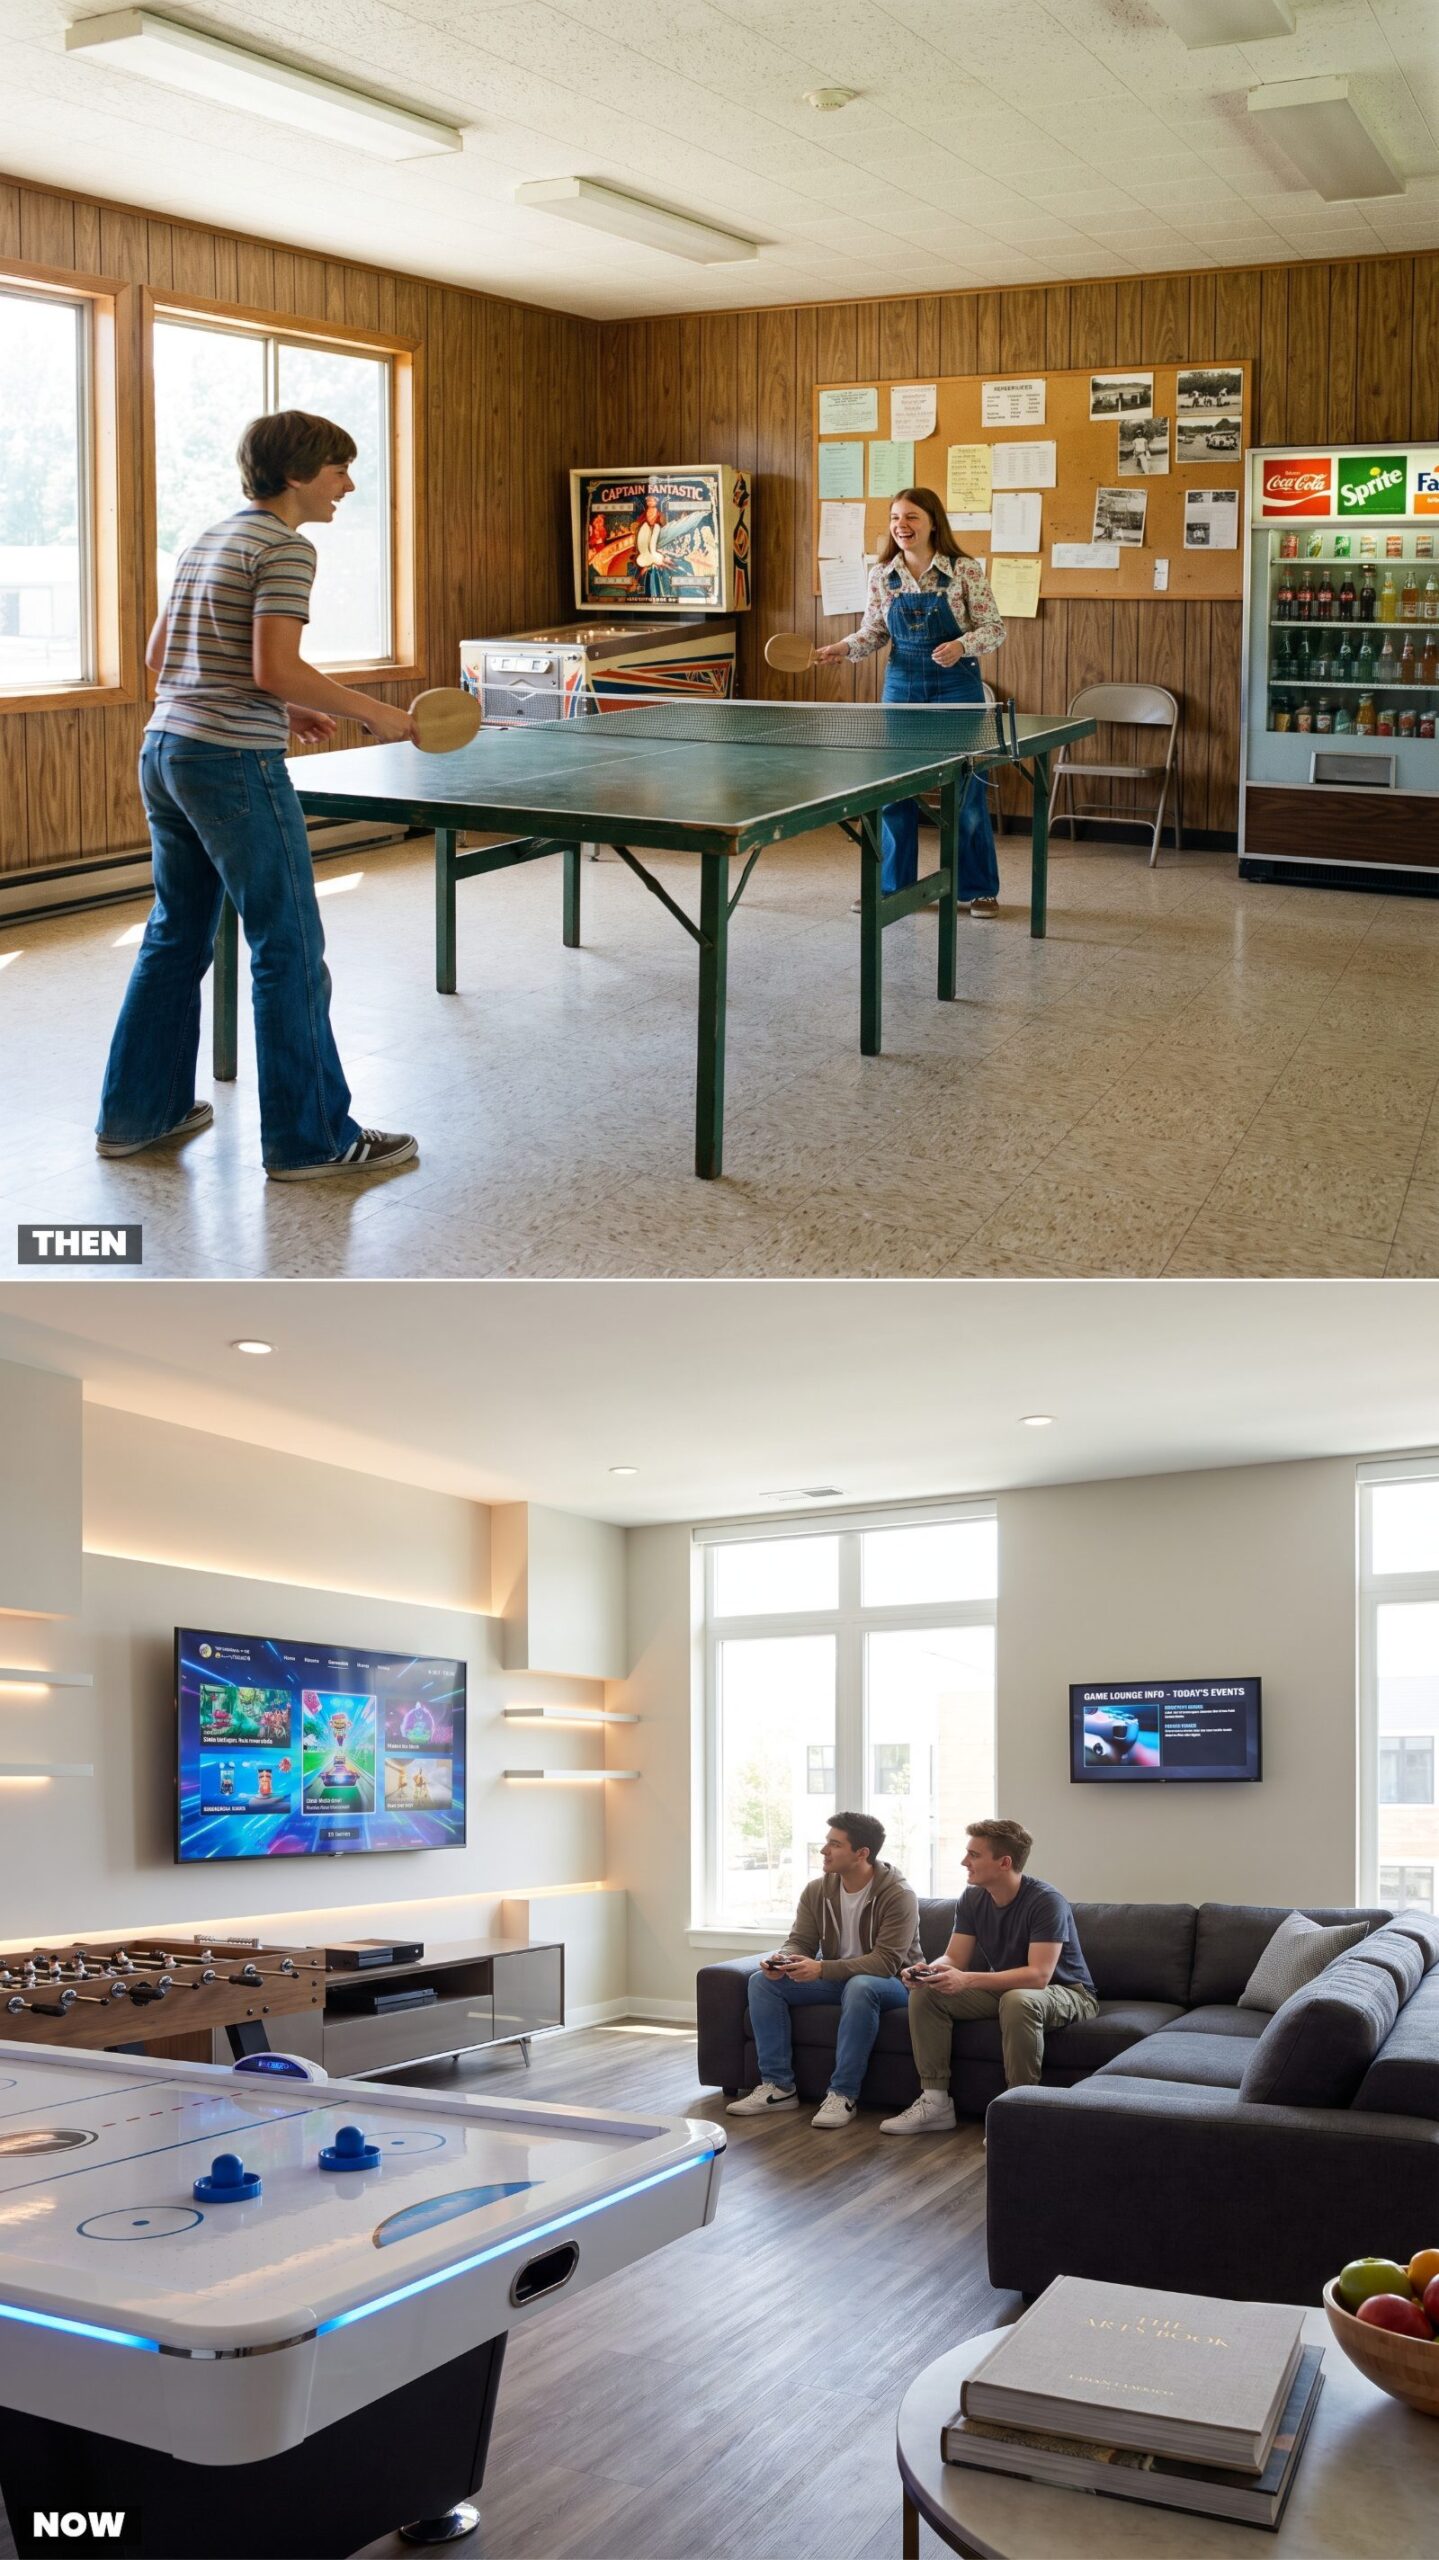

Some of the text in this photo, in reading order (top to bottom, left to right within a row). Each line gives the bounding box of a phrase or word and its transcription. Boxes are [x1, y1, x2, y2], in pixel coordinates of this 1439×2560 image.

[601, 484, 703, 503] CAPTAIN FANTASTIC
[1340, 467, 1403, 507] Sprite
[1084, 1692, 1108, 1701] GAME
[1110, 1691, 1143, 1700] LOUNGE
[1144, 1690, 1165, 1699] INFO
[1172, 1688, 1209, 1698] TODAY'S
[1211, 1687, 1245, 1697] EVENTS
[1137, 2317, 1183, 2330] THE
[1156, 2329, 1231, 2348] BOOK
